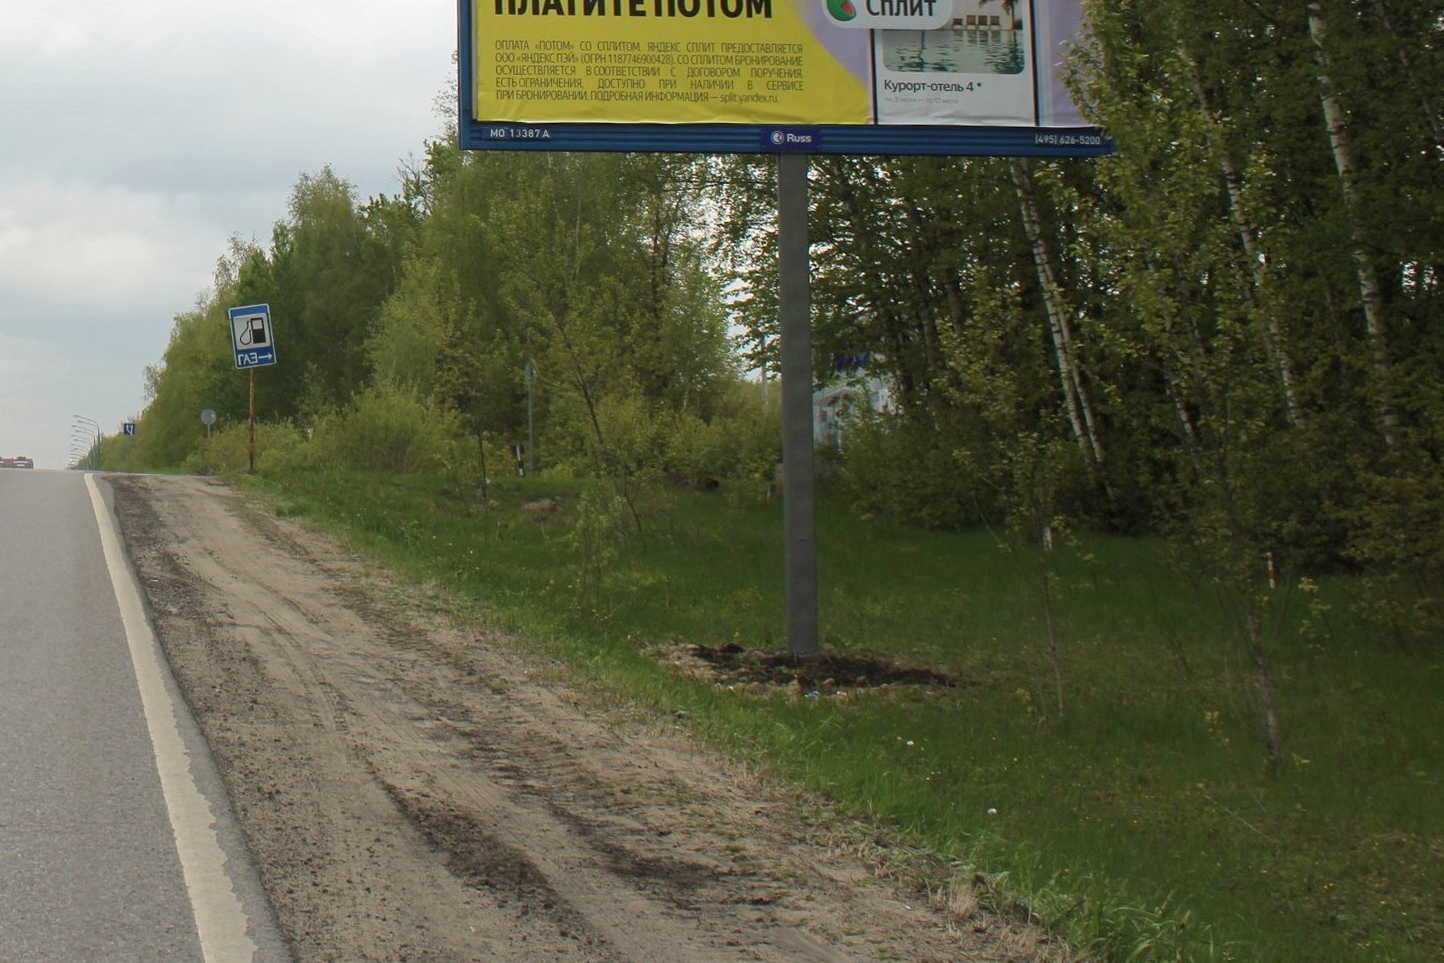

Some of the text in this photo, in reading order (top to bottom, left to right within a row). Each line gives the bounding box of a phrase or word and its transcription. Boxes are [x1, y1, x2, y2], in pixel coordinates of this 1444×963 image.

[495, 40, 529, 51] ОПЛАТА
[580, 41, 592, 51] СО
[647, 42, 681, 53] ЯНДЕКС
[686, 42, 715, 52] СПЛИТ
[721, 43, 803, 54] ПРЕДОСТАВЛЯЕТСЯ
[495, 52, 515, 63] ООО
[581, 53, 606, 65] (ОГРН
[677, 55, 689, 65] СО
[690, 55, 733, 65] СПЛИТОМ
[735, 55, 803, 66] БРОНИРОВАНИЕ
[496, 65, 576, 76] ОСУЩЕСТВЛЯЕТСЯ
[586, 66, 592, 76] В
[593, 66, 660, 77] СООТВЕТСТВИИ
[671, 67, 676, 77] С
[687, 67, 740, 78] ДОГОВОРОМ
[496, 77, 517, 88] ЕСТЬ
[598, 78, 645, 89] ДОСТУПНО
[659, 79, 677, 89] ПРИ
[691, 80, 734, 90] НАЛИЧИИ
[748, 80, 753, 90] В
[766, 80, 804, 91] СЕРВИСЕ
[884, 79, 964, 93] Курорт-отель
[496, 90, 515, 100] ПРИ
[590, 91, 644, 102] ПОДРОБНАЯ
[645, 91, 709, 103] ИНФОРМАЦИЯ
[490, 128, 505, 138] МО
[510, 129, 540, 138] 13387
[787, 133, 812, 143] Russ
[1035, 134, 1101, 145] (495) 626-5200
[237, 352, 259, 366] ГАЗ
